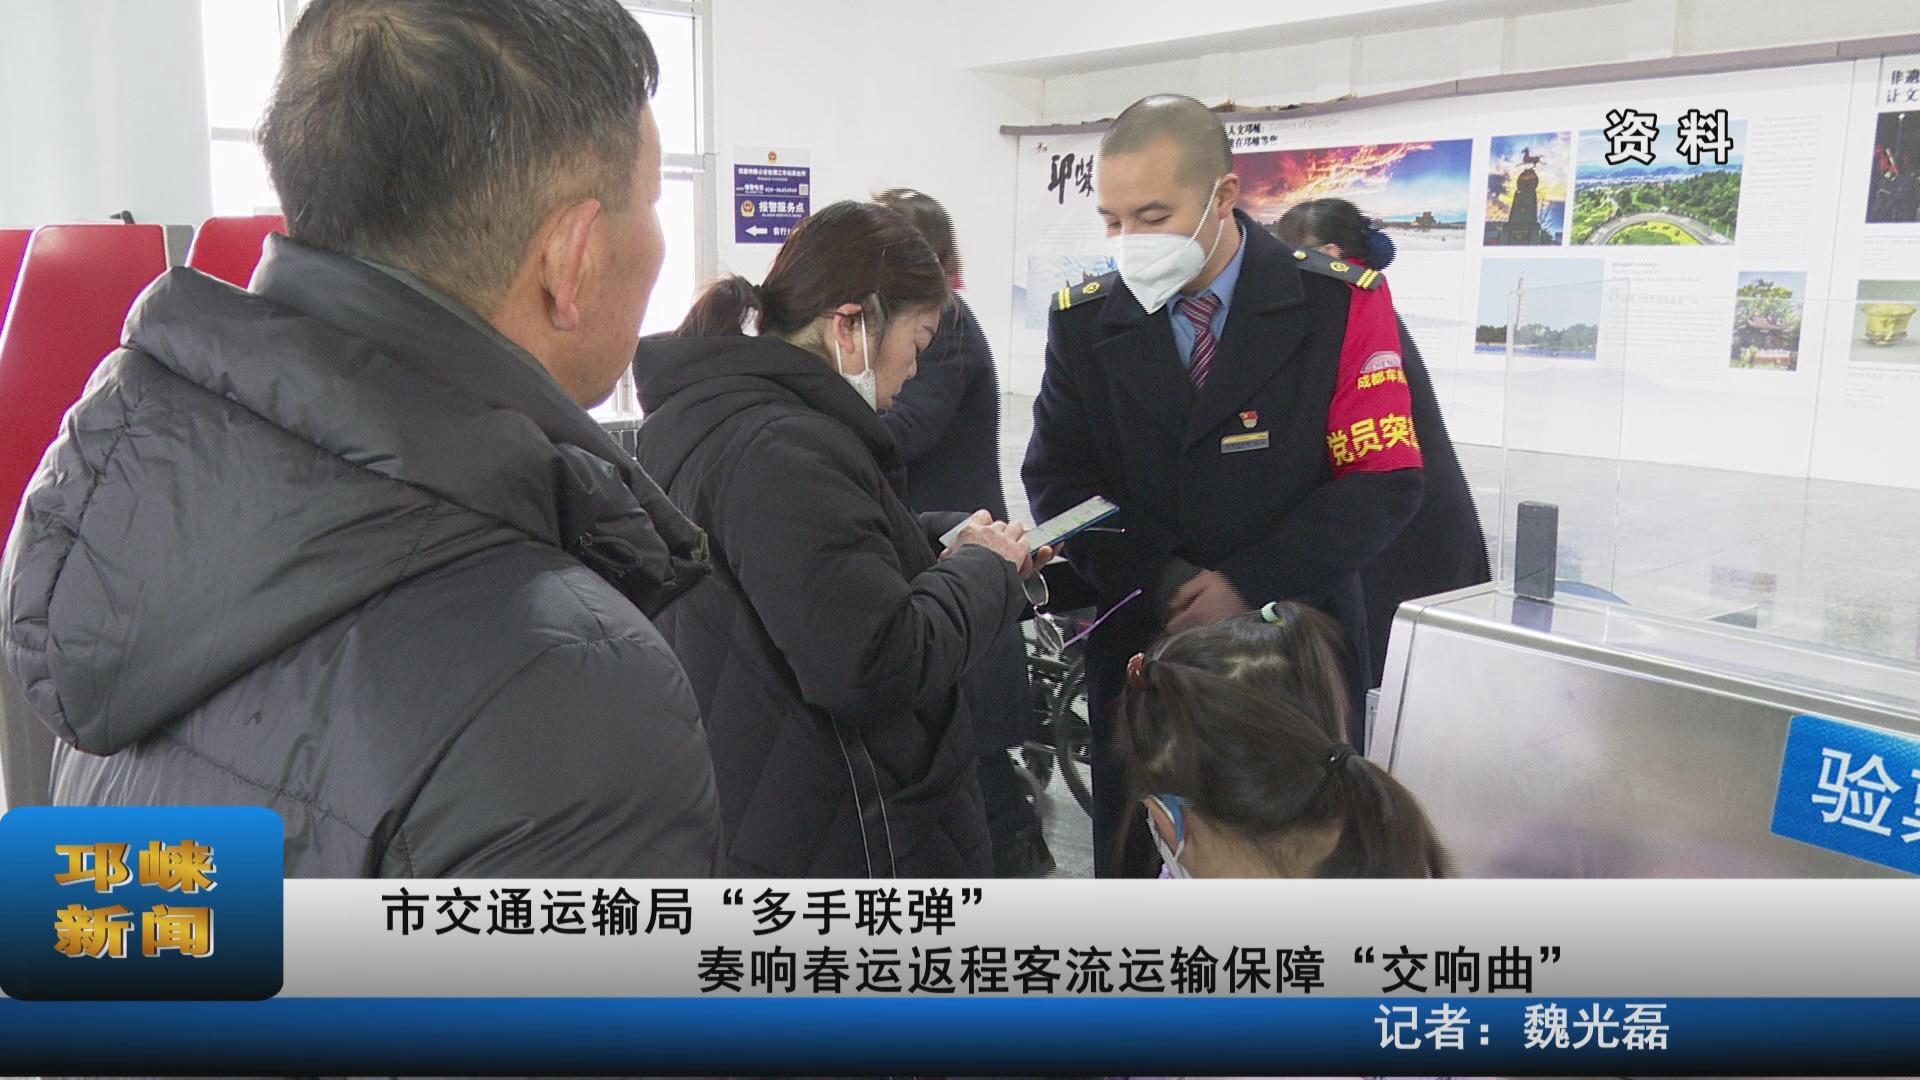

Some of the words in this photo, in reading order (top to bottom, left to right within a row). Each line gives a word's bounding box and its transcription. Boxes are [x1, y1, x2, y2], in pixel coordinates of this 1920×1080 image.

[759, 201, 804, 213] 报警服务点
[1811, 747, 1920, 844] 验
